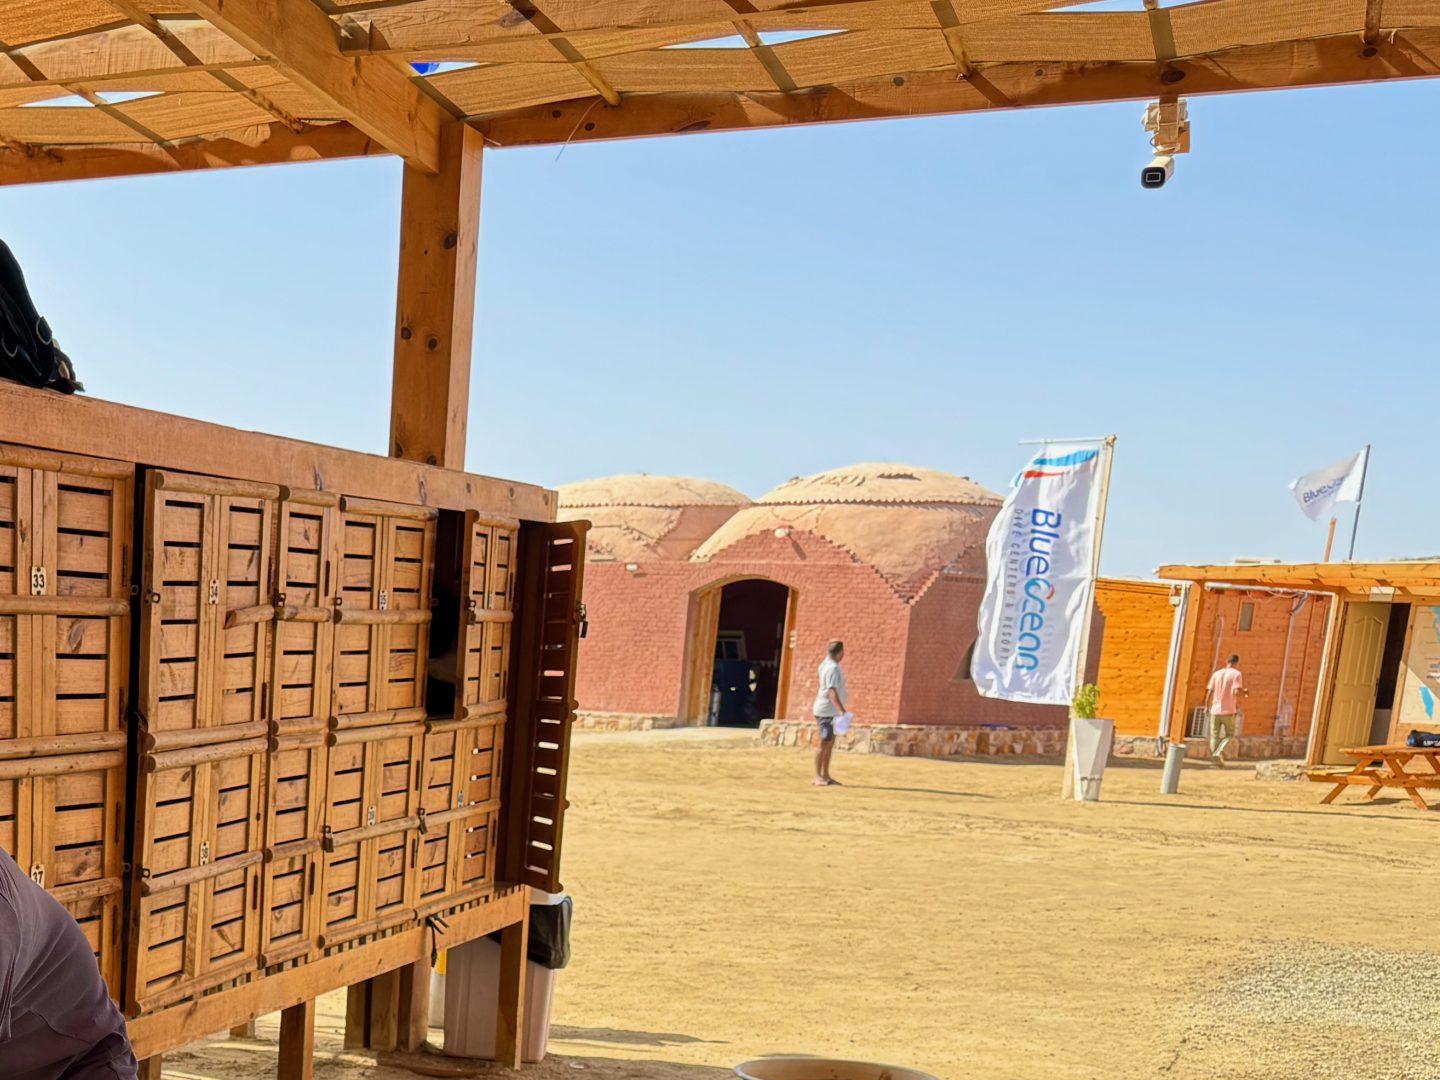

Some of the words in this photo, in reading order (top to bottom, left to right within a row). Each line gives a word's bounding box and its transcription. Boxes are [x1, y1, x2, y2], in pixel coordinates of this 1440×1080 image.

[1007, 543, 1020, 595] CENTERS
[33, 573, 45, 588] 33
[32, 870, 44, 884] 37
